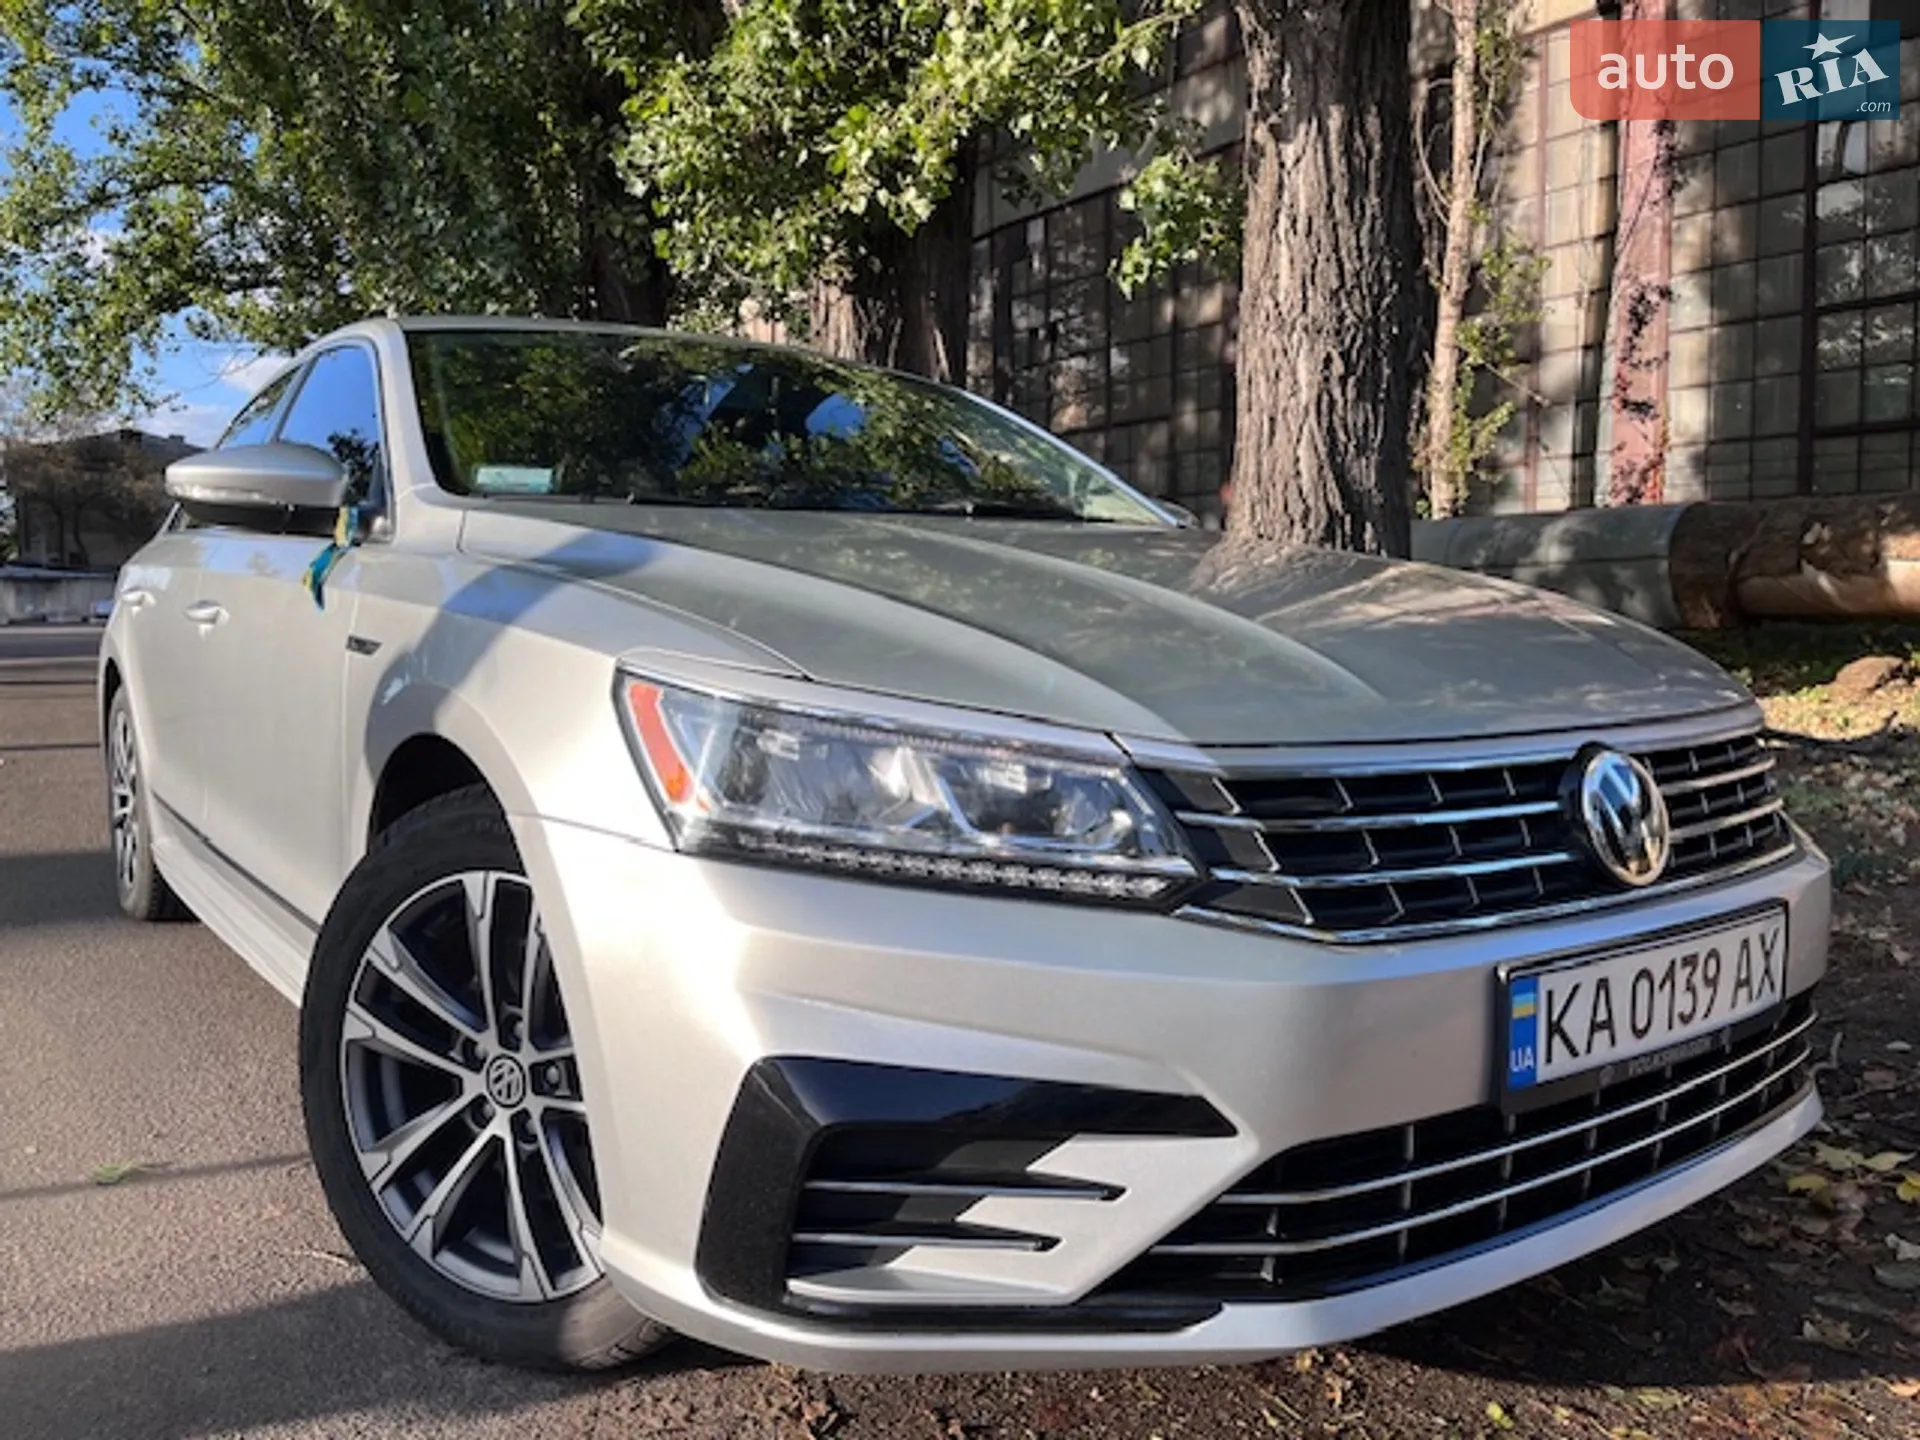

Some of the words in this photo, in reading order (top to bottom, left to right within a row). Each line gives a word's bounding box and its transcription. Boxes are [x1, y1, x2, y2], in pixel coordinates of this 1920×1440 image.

[1545, 977, 1617, 1065] KA
[1630, 948, 1721, 1039] 0139
[1731, 928, 1780, 1009] AX
[1511, 1047, 1534, 1073] UA
